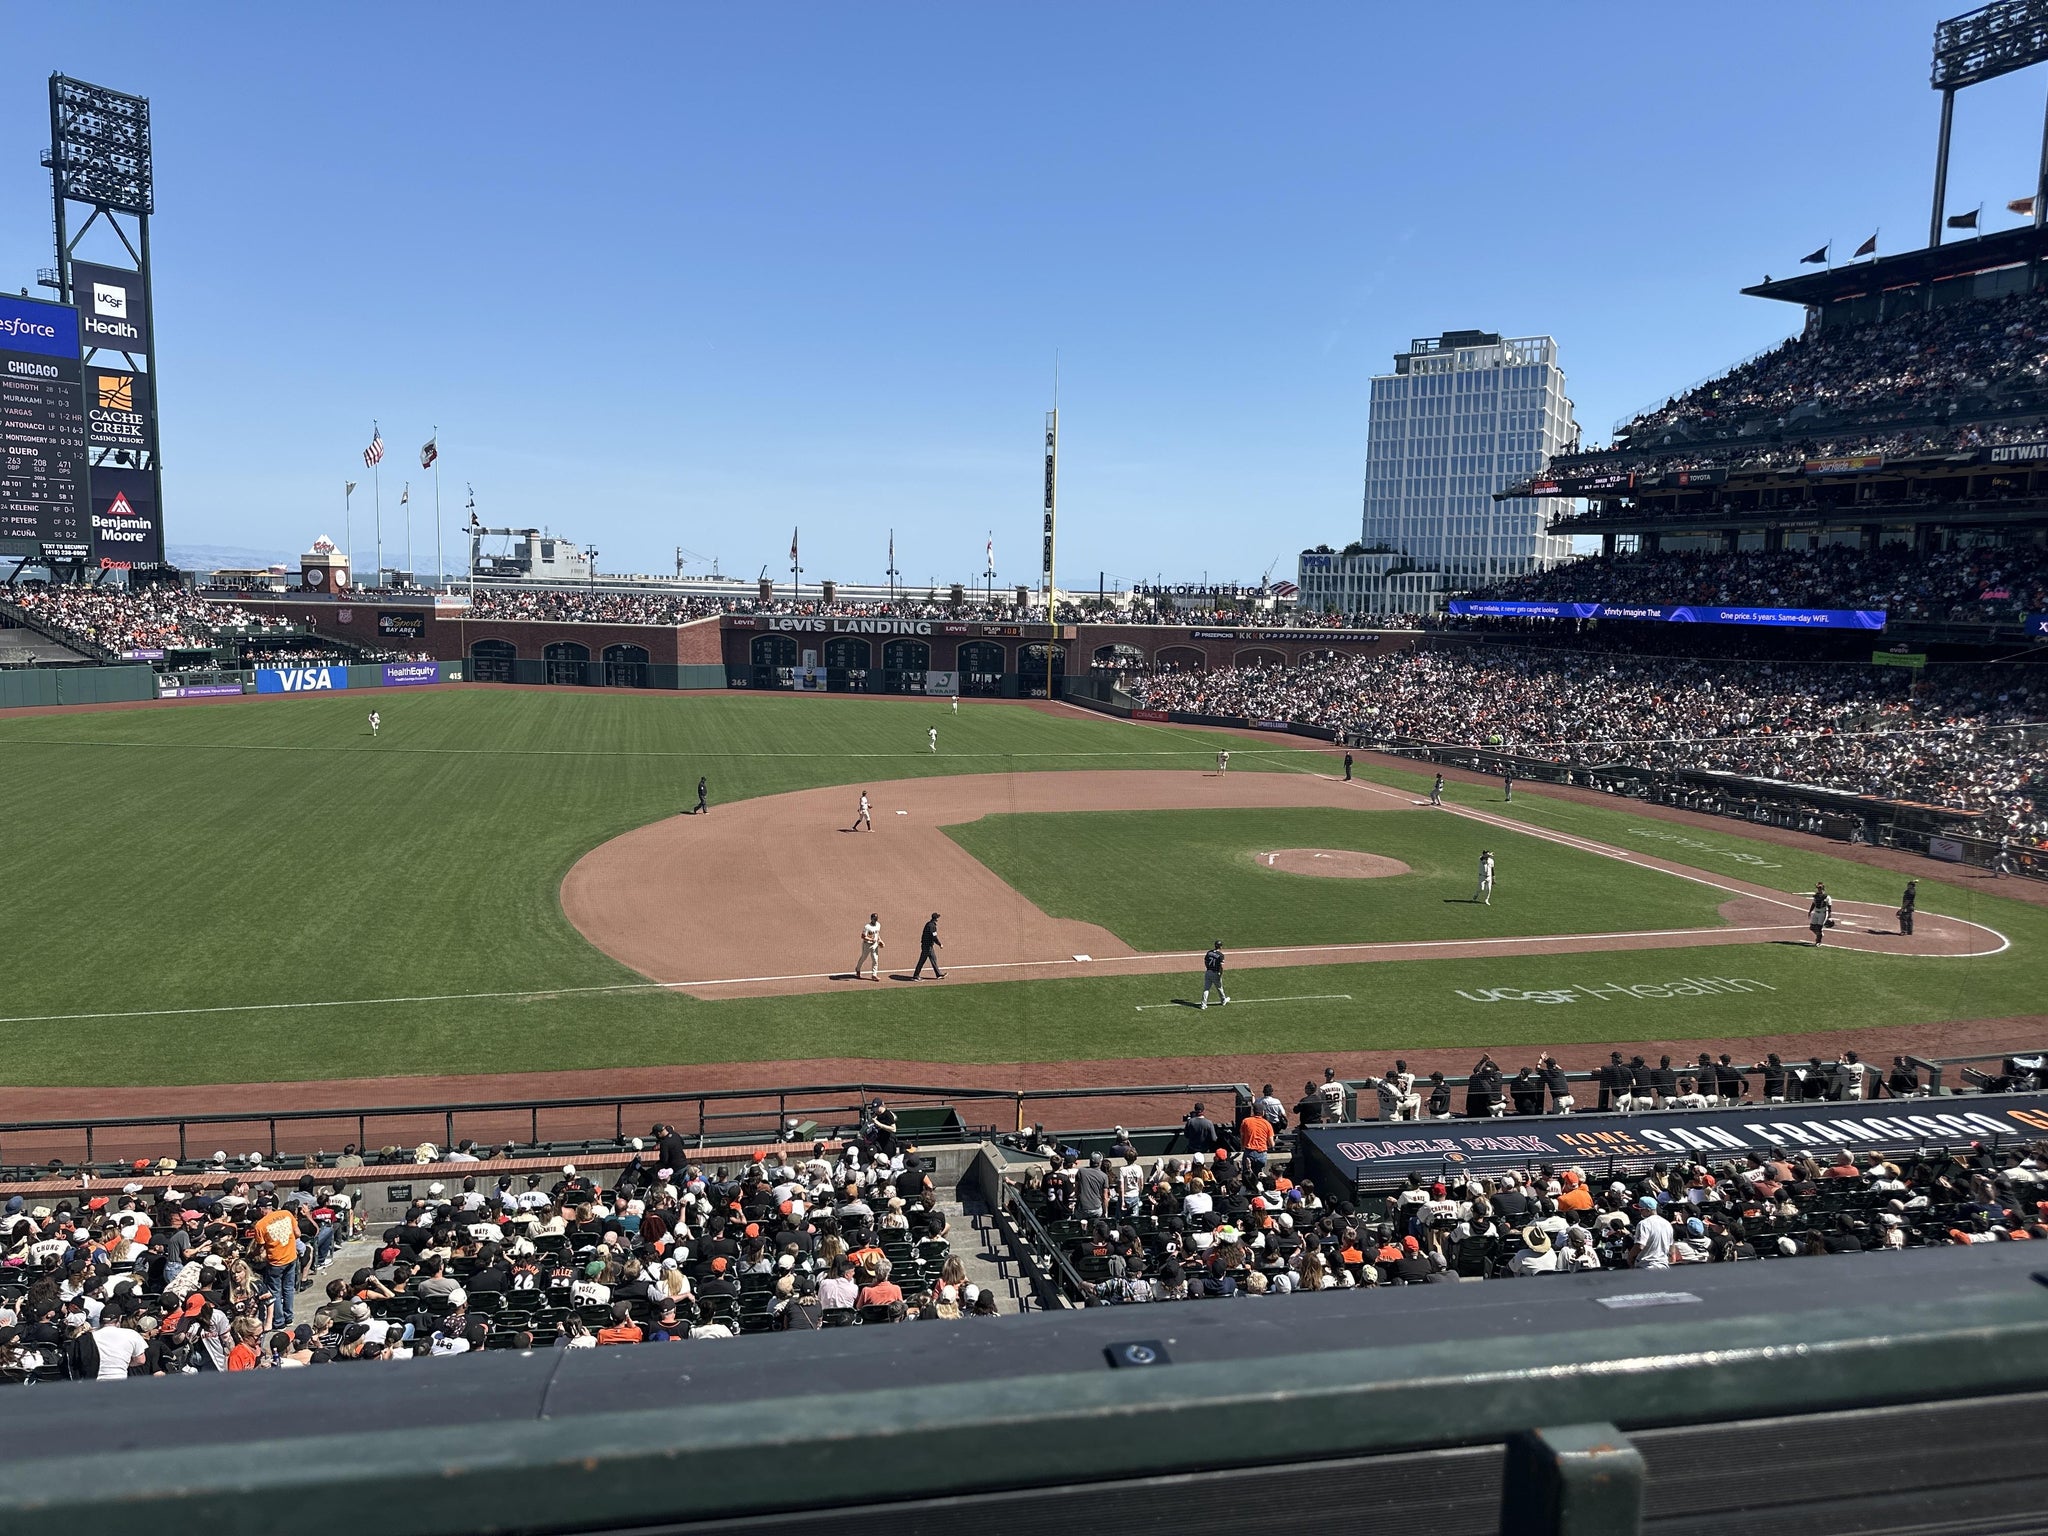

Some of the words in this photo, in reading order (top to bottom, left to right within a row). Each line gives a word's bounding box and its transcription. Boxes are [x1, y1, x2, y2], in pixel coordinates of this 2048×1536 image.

[98, 293, 122, 308] UCSF
[85, 317, 138, 338] Health
[8, 360, 58, 378] CHICAGO
[3, 381, 39, 391] MEIDROTH
[58, 387, 69, 395] 1-4
[3, 394, 42, 405] MURAKAMI
[4, 408, 33, 416] VARGAS
[89, 410, 143, 424] CACHE
[5, 421, 45, 430] ANTONACCI
[91, 422, 142, 436] CREEK
[5, 434, 47, 444] MONTGOMERY
[9, 447, 38, 456] QUERO
[1818, 461, 1849, 472] Surfside
[92, 516, 151, 529] Benjamin
[101, 529, 144, 542] Moore
[100, 558, 132, 570] Coors
[133, 562, 158, 570] LIGHT
[1302, 556, 1331, 567] VISA
[1133, 585, 1172, 594] BANK
[1176, 585, 1194, 595] OF
[1198, 585, 1265, 596] AMERICA
[1604, 608, 1622, 617] xfinity
[1623, 609, 1646, 618] Imagine
[1778, 614, 1811, 623] Same-day
[392, 617, 422, 628] Sports
[834, 620, 932, 634] LANDING
[254, 662, 293, 670] WELCOME
[388, 667, 436, 677] HealthEquity
[275, 669, 332, 690] VISA
[1209, 957, 1216, 967] 71
[1454, 987, 1582, 1004] UCSF
[1572, 976, 1777, 1001] Health
[1556, 1130, 1636, 1145] HOME
[1640, 1126, 1751, 1152] SAN
[1744, 1112, 2019, 1147] FRANCISCO
[1337, 1138, 1454, 1162] ORACLE
[1460, 1134, 1559, 1153] PARK
[1576, 1146, 1607, 1156] OF
[1609, 1144, 1656, 1155] THE
[36, 1243, 60, 1252] CHUNG
[514, 1274, 534, 1290] 26
